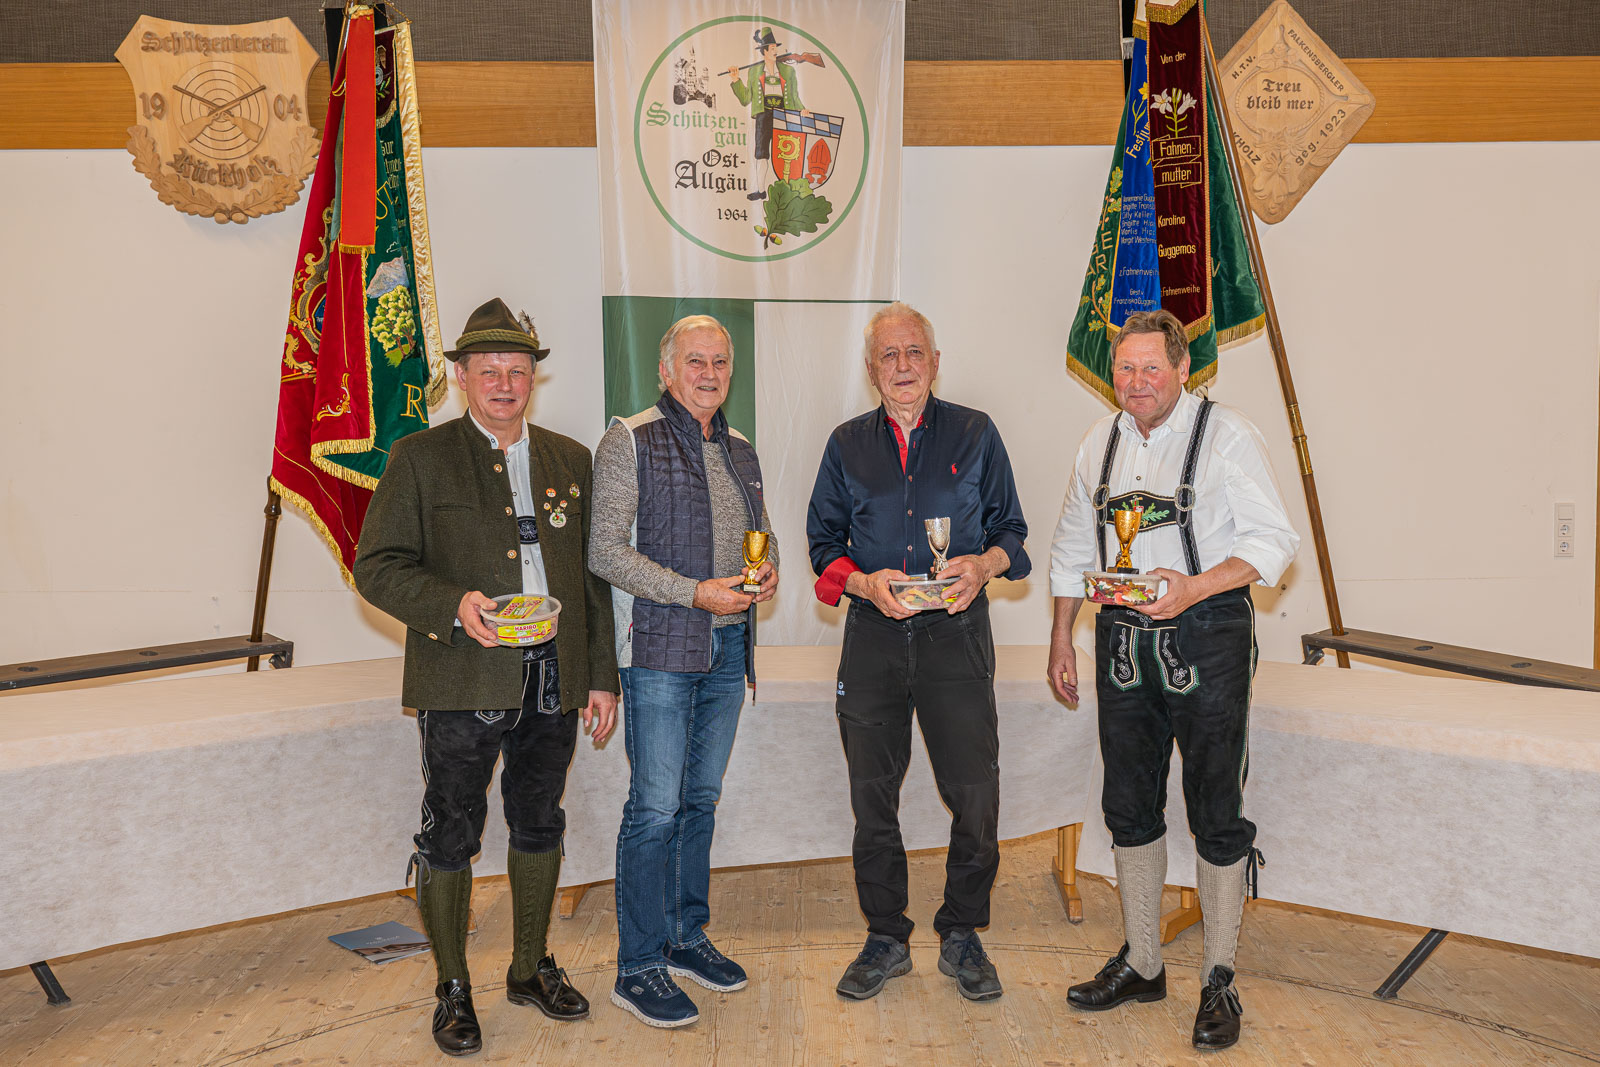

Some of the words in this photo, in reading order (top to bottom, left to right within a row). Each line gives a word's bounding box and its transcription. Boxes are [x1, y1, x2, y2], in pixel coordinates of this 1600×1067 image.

[140, 31, 288, 56] Schützenverein
[1175, 51, 1187, 62] der
[1287, 28, 1345, 92] FALKENSBERGLER
[1231, 54, 1256, 80] H.T.V.
[1261, 78, 1302, 93] Treu
[139, 92, 166, 120] 19
[273, 94, 302, 121] 04
[1246, 95, 1281, 110] bleib
[1287, 100, 1314, 110] mer
[646, 101, 746, 131] Schützen-
[1319, 108, 1346, 138] 1923
[714, 131, 747, 148] gau
[702, 149, 746, 168] Ost-
[674, 160, 748, 194] Allgäu
[1161, 168, 1192, 183] mutter
[717, 207, 748, 222] 1964
[1157, 215, 1186, 229] Karolina
[1158, 244, 1196, 260] Guggemos
